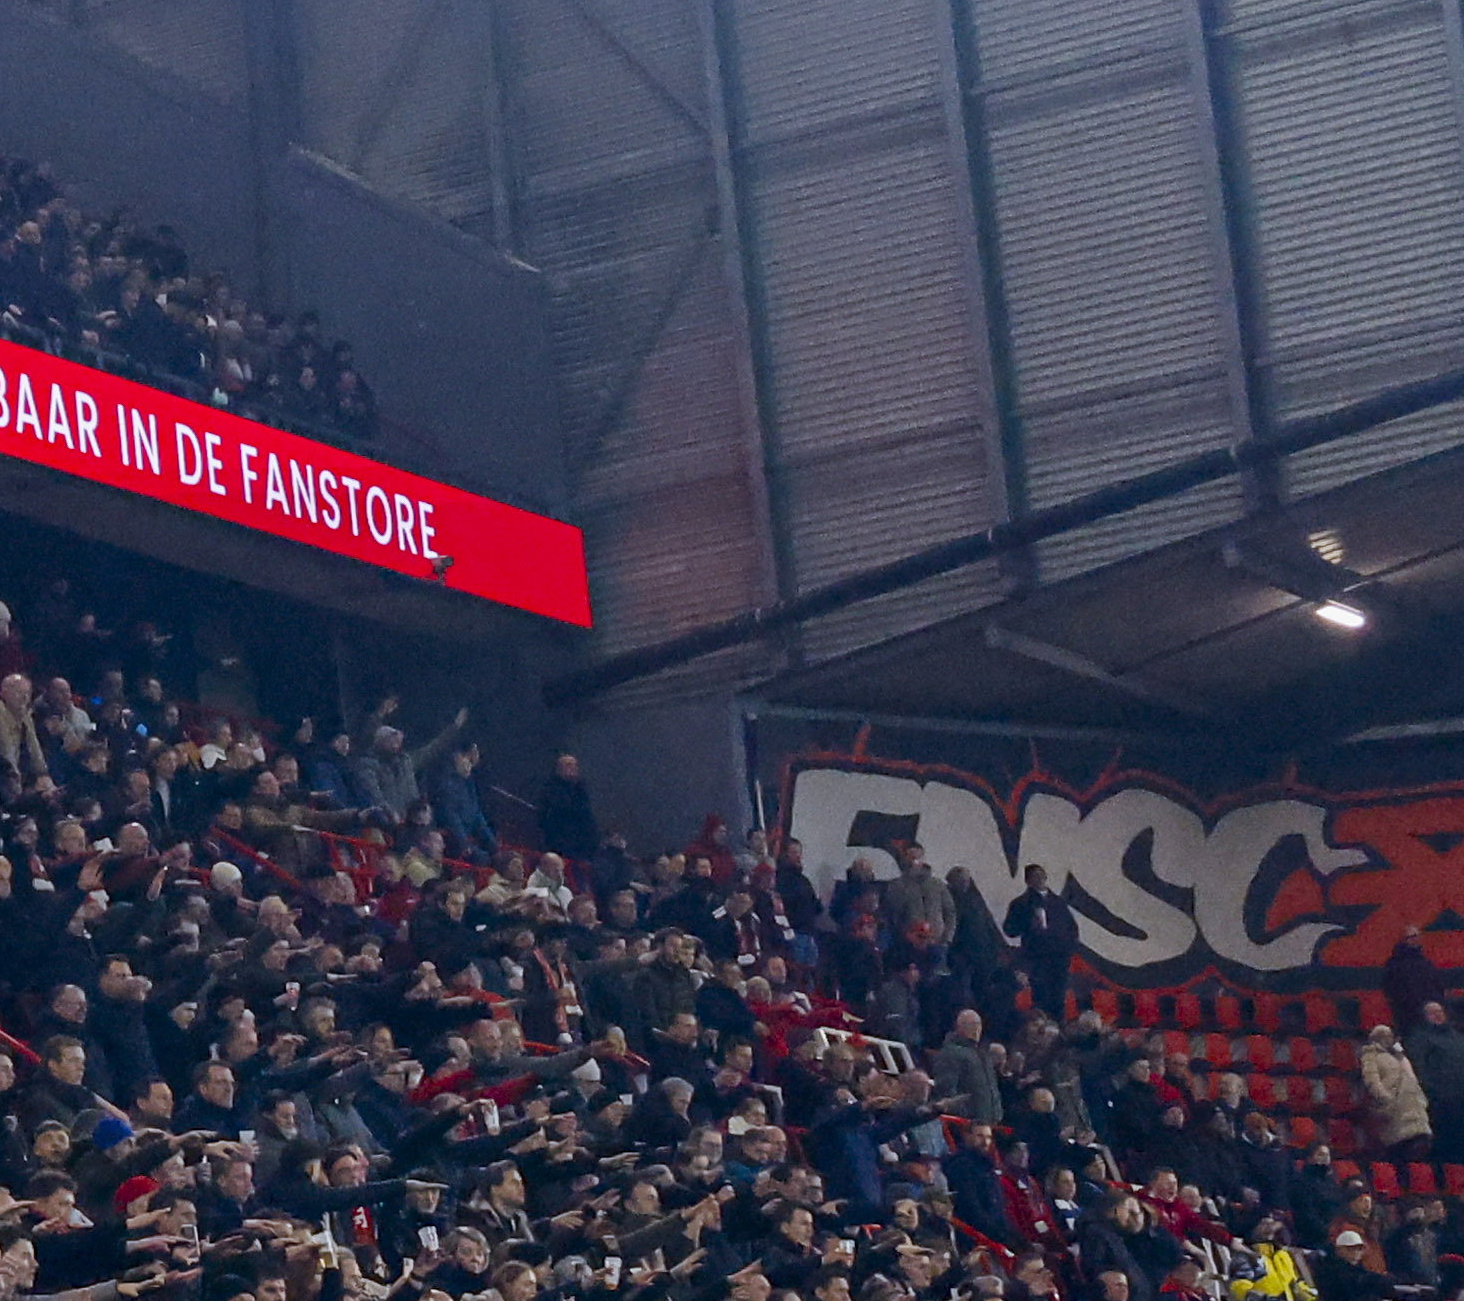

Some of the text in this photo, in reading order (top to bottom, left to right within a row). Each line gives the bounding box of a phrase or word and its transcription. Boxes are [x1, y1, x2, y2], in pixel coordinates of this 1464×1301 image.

[116, 402, 160, 477] IN
[175, 421, 227, 497] DE
[240, 442, 439, 560] FANSTORE
